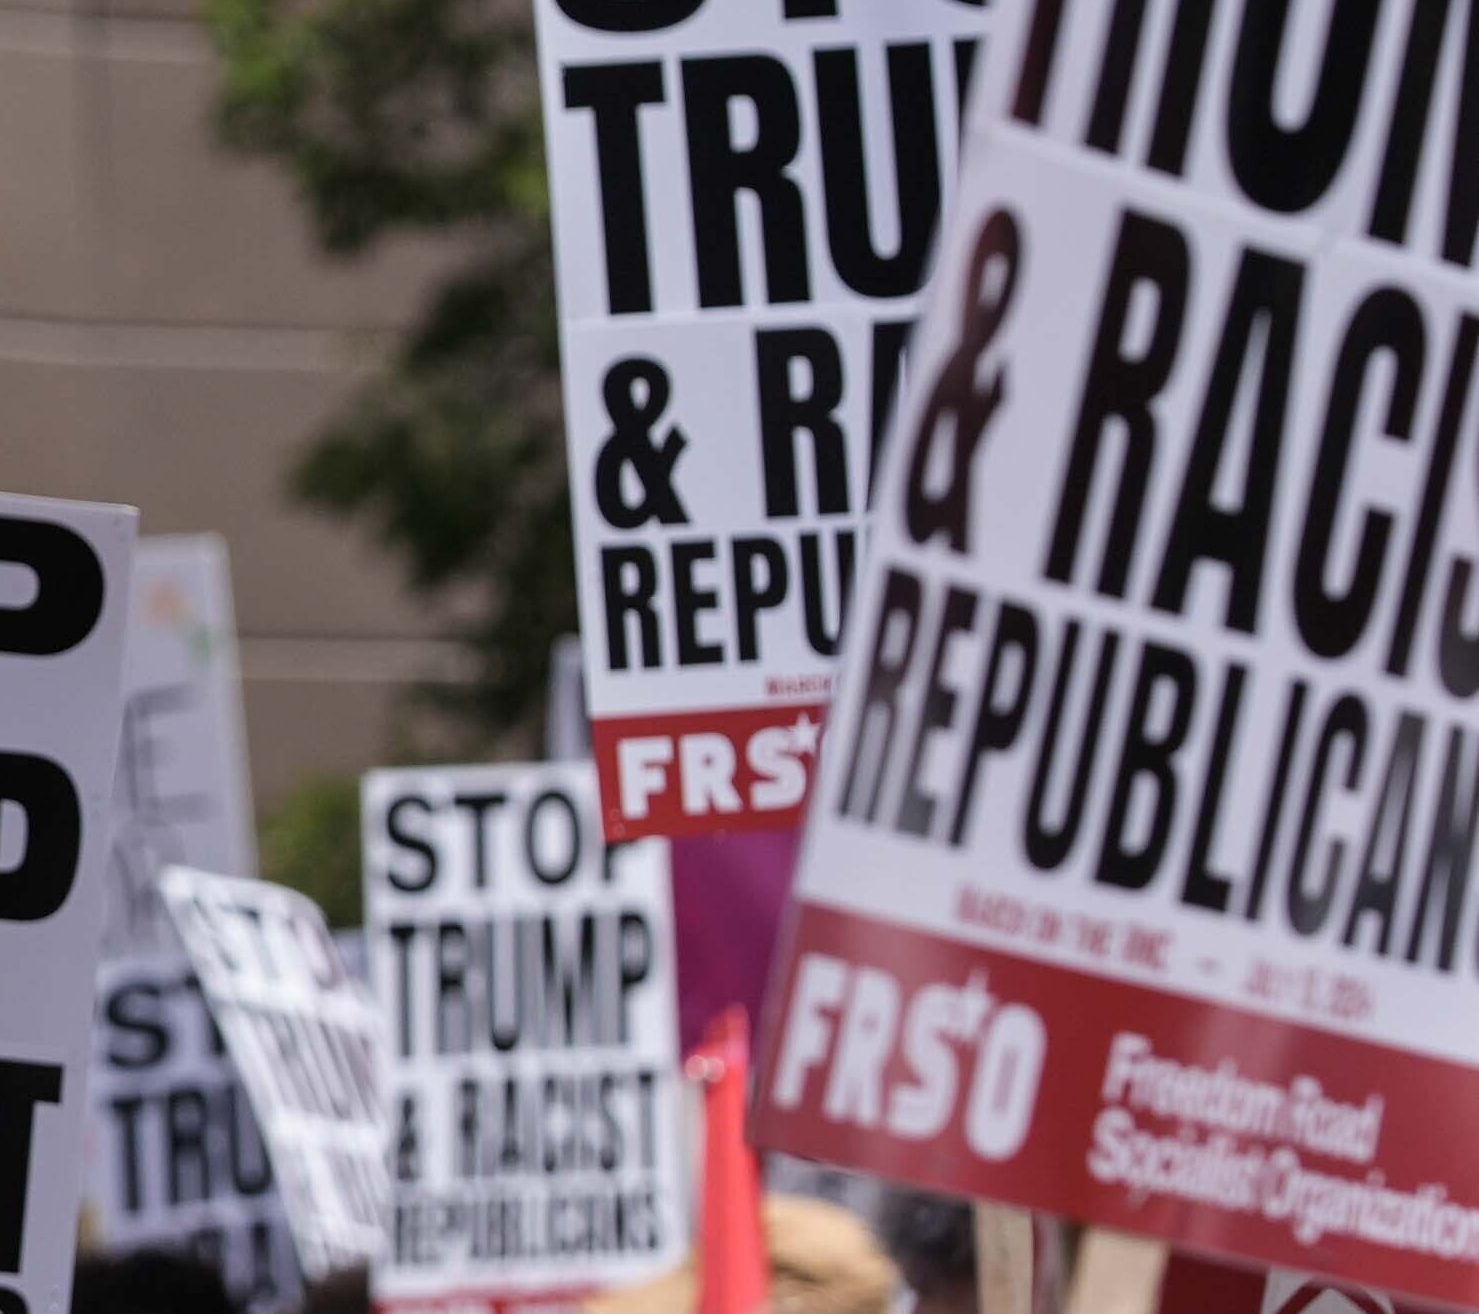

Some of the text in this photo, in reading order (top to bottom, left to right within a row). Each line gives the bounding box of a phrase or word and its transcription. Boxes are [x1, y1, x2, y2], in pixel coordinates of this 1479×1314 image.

[563, 37, 982, 315] TRU
[596, 356, 690, 532] &
[902, 206, 1027, 552] &
[617, 715, 818, 821] FRS
[835, 556, 1479, 980] REPUBLICAN
[389, 910, 653, 1059] TRUMP
